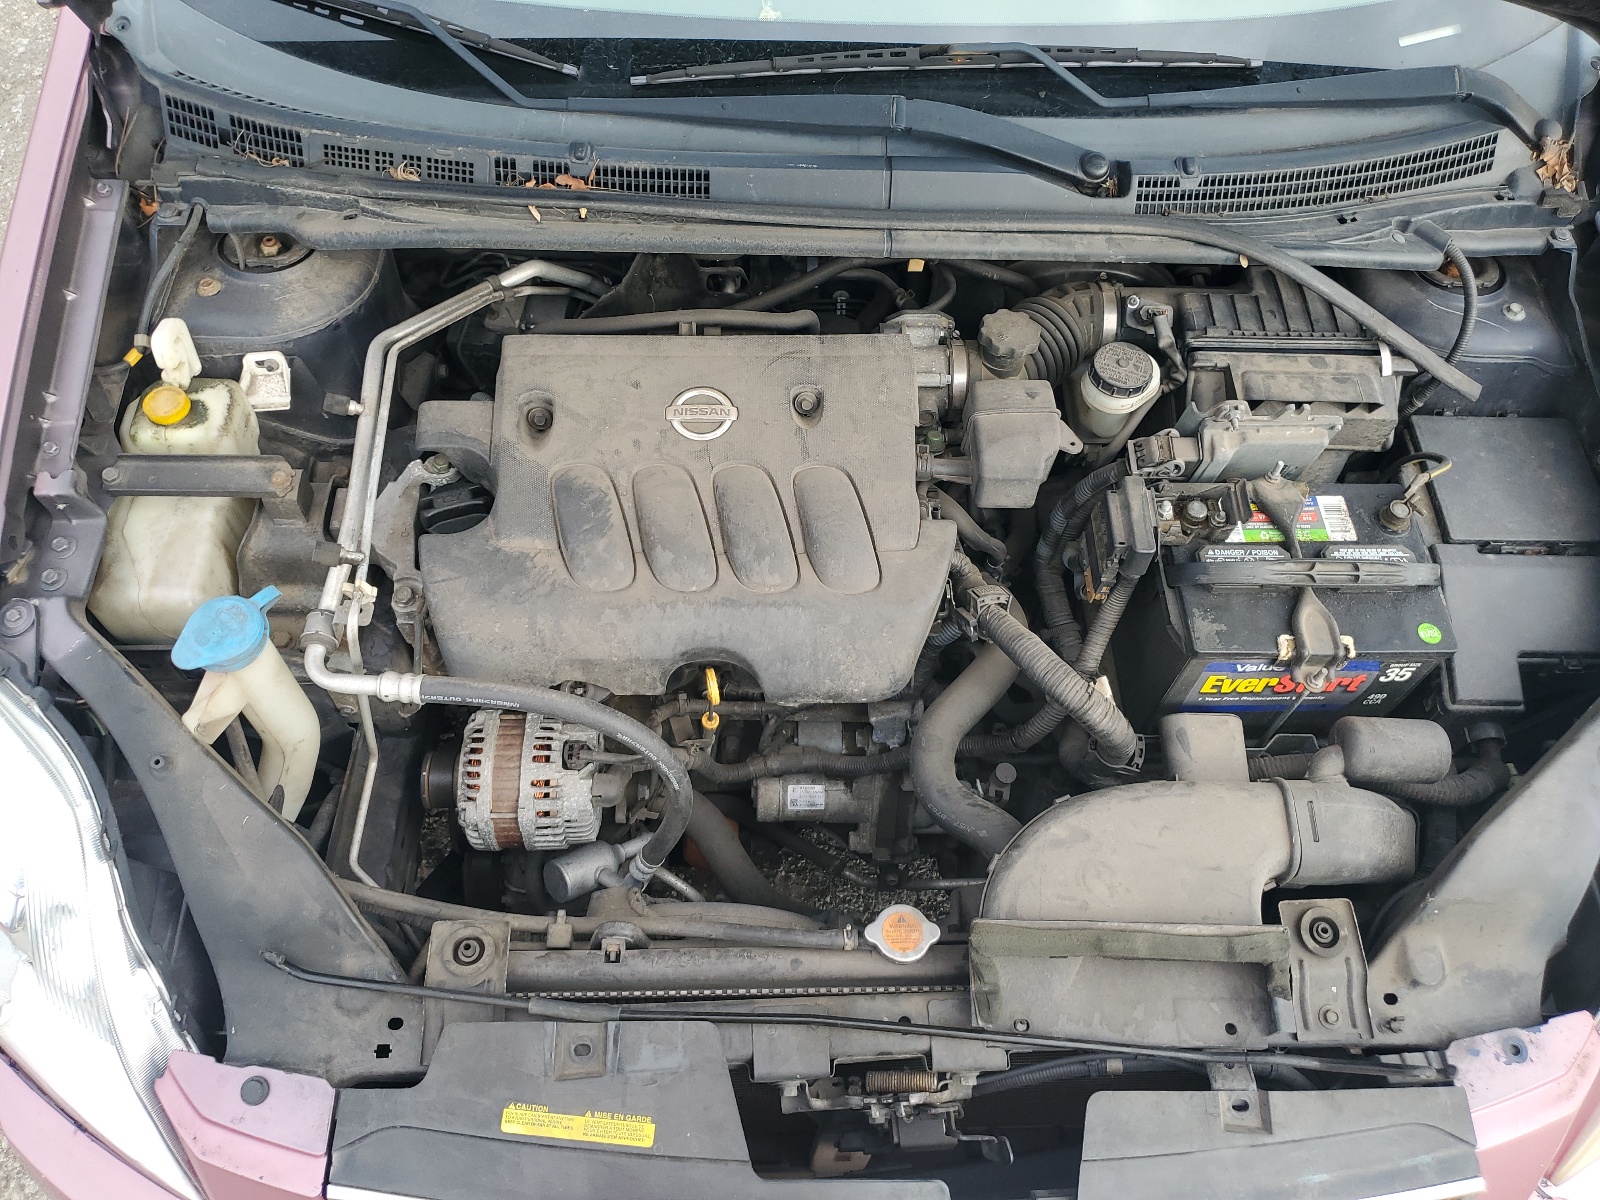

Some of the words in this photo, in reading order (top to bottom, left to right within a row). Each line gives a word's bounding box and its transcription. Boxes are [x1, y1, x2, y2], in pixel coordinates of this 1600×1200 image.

[673, 408, 731, 416] NISSAN
[1378, 667, 1417, 682] 35
[516, 1102, 549, 1113] CAUTION
[593, 1110, 612, 1120] MISE
[613, 1112, 624, 1121] EN
[626, 1114, 652, 1123] GARDE
